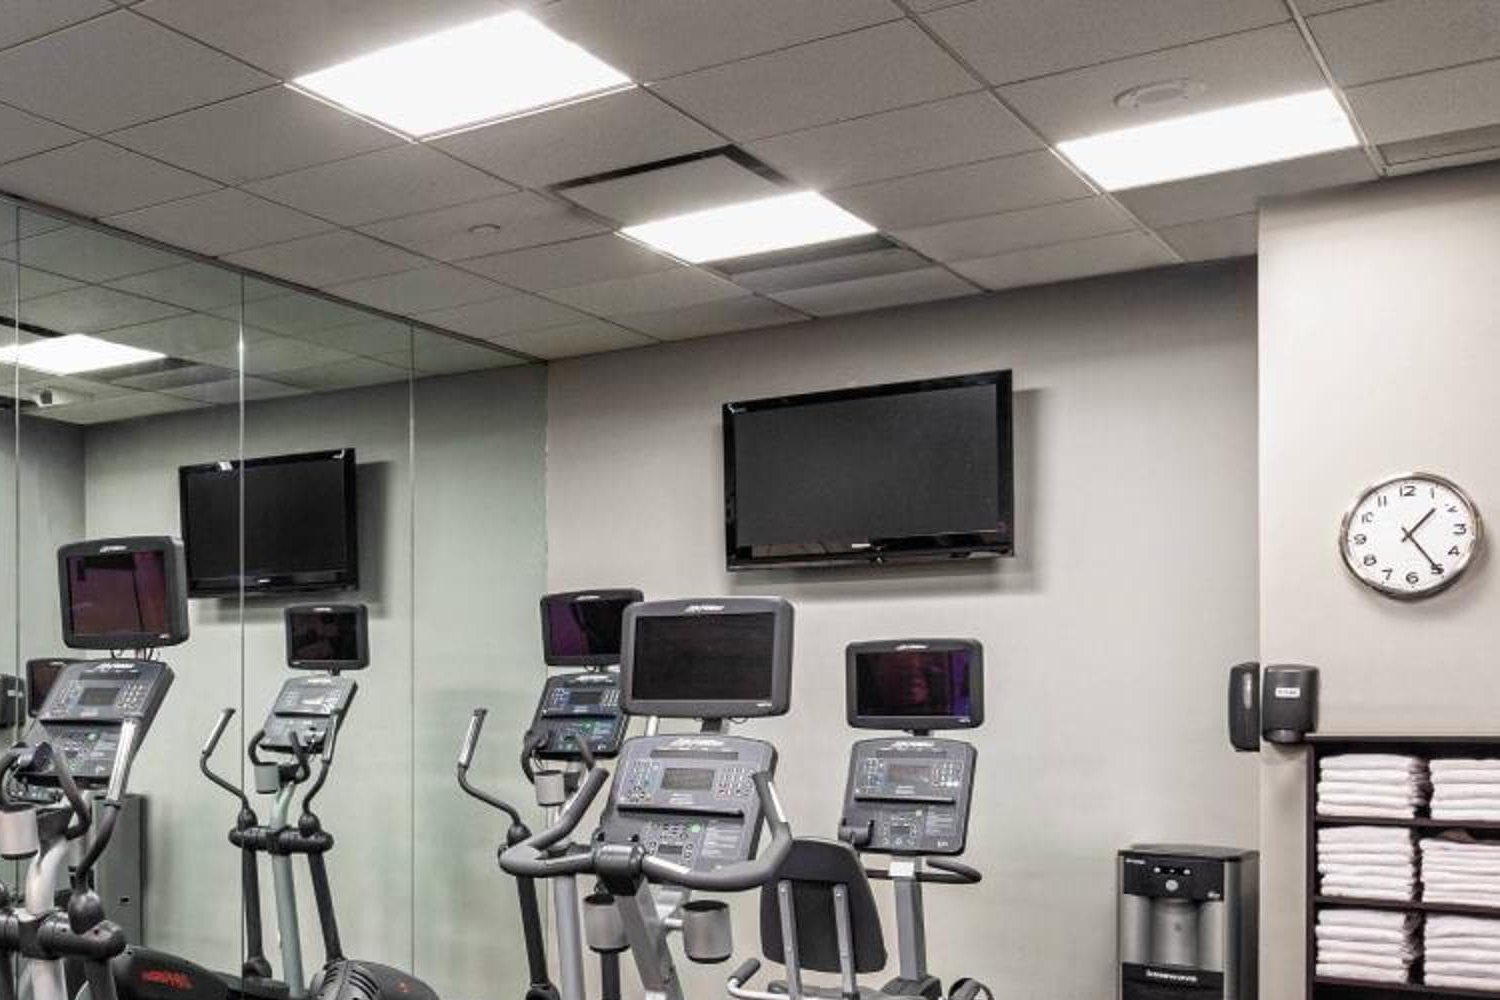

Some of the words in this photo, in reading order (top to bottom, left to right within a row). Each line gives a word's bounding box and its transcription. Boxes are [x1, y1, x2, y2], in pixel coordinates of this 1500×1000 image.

[1400, 485, 1416, 497] 12
[1377, 495, 1388, 508] 11
[1361, 511, 1375, 524] 10
[1453, 523, 1468, 536] 3
[1353, 533, 1368, 545] 9
[1447, 545, 1461, 556] 4
[1363, 553, 1378, 567] 8
[1381, 568, 1394, 581] 7
[1405, 571, 1420, 585] 6
